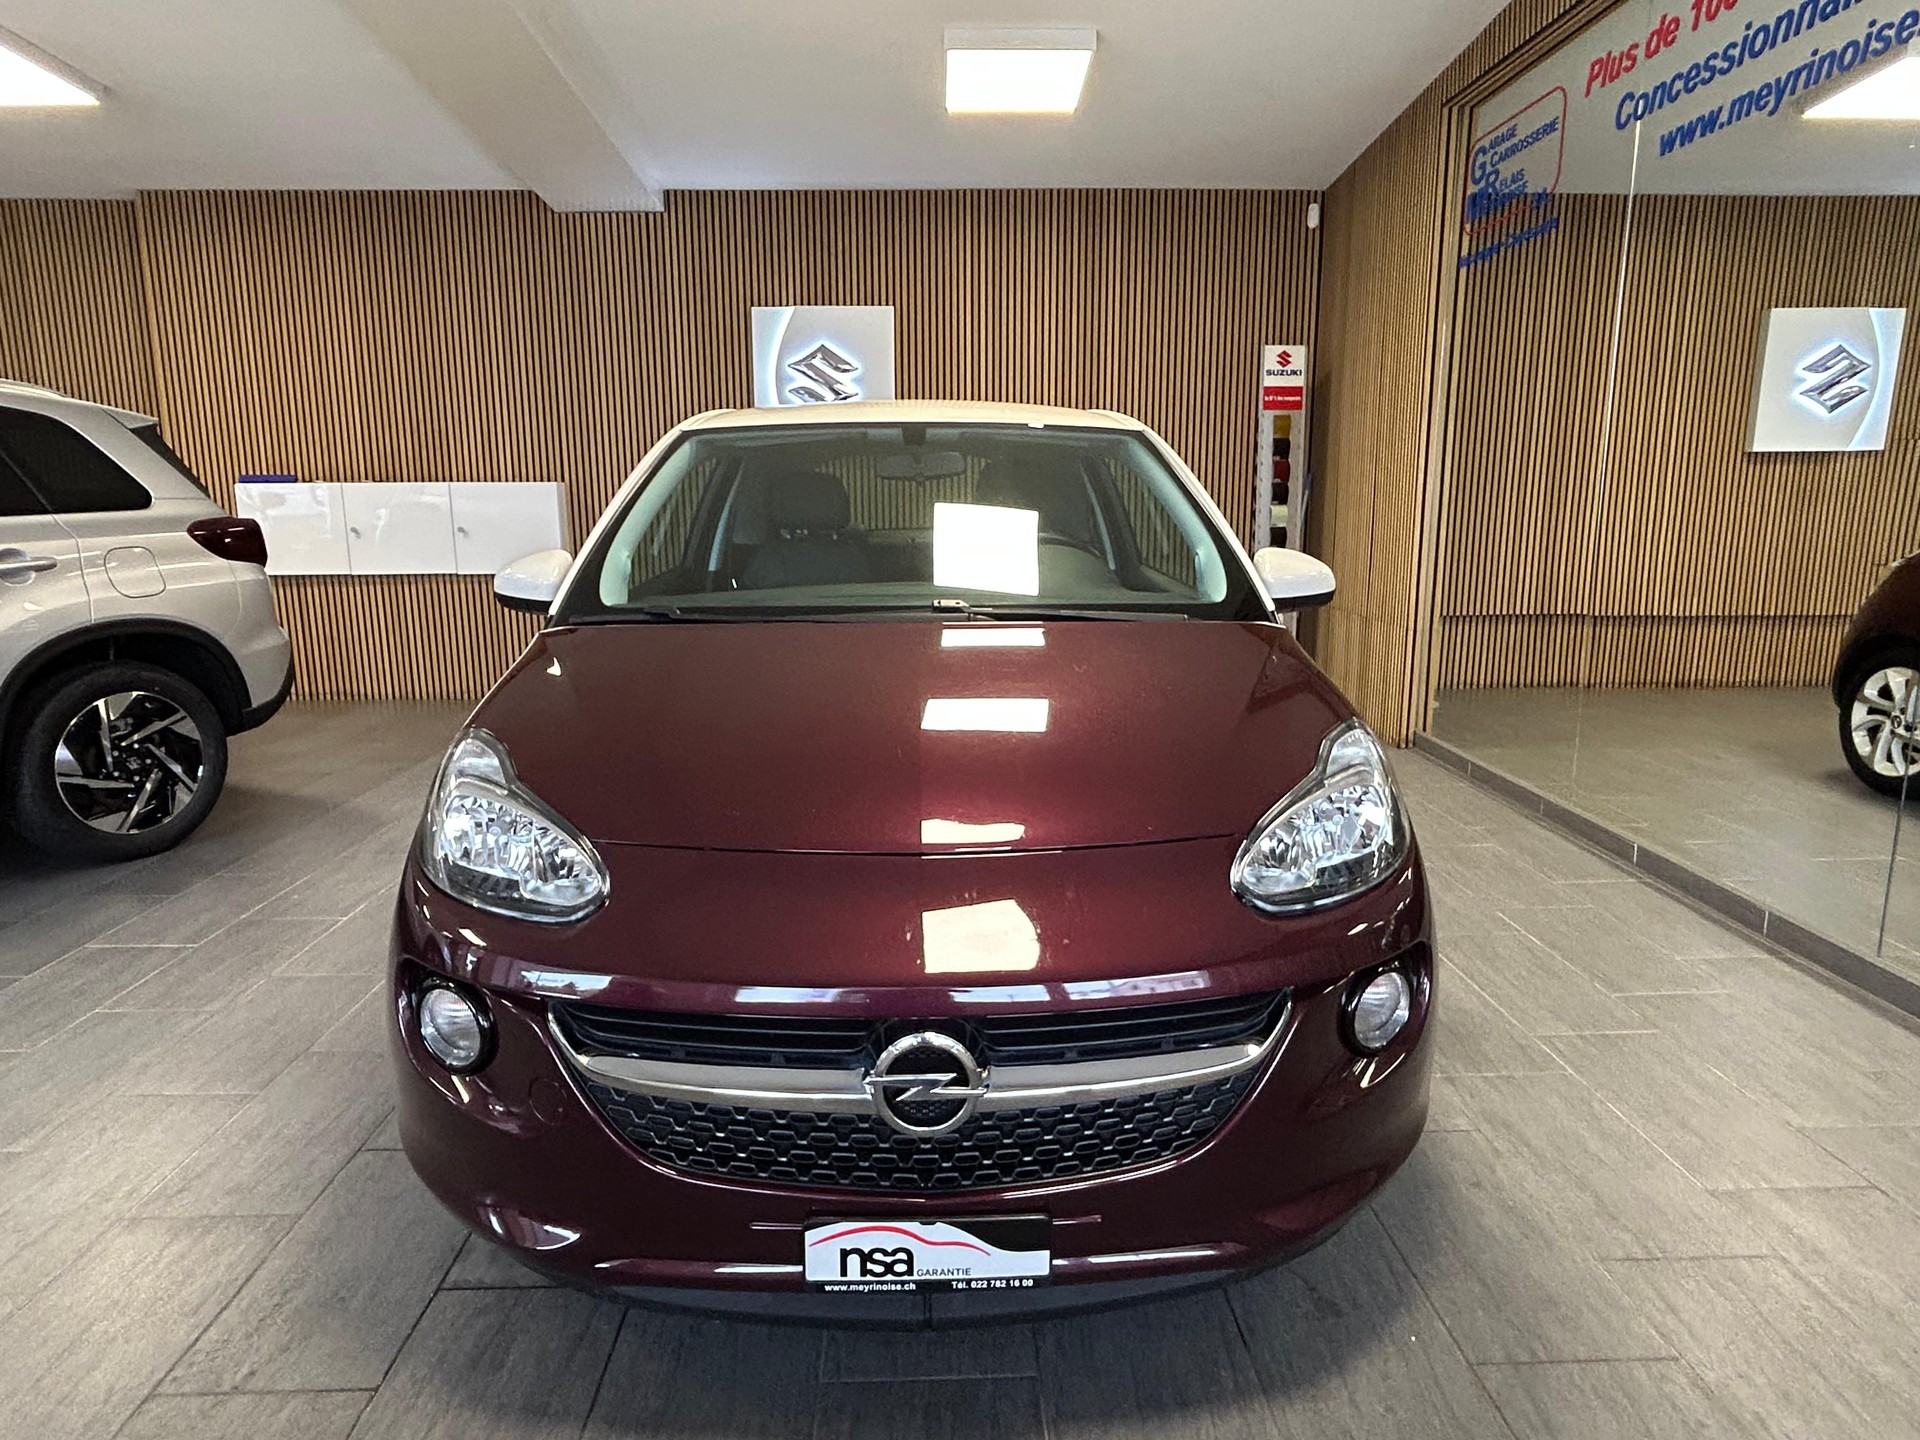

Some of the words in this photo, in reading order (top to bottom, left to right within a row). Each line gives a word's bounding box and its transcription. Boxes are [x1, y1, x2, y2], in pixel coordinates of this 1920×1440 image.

[1585, 43, 1640, 98] Plus
[1645, 13, 1681, 59] de
[1691, 0, 1738, 32] 10
[1265, 369, 1302, 377] SUZUKI
[839, 1247, 915, 1278] nsa
[916, 1267, 972, 1278] GARANTIE
[824, 1282, 916, 1292] www.meyrinoise.ch
[970, 1280, 988, 1289] 022
[989, 1279, 1007, 1288] 782
[1021, 1278, 1034, 1287] 00
